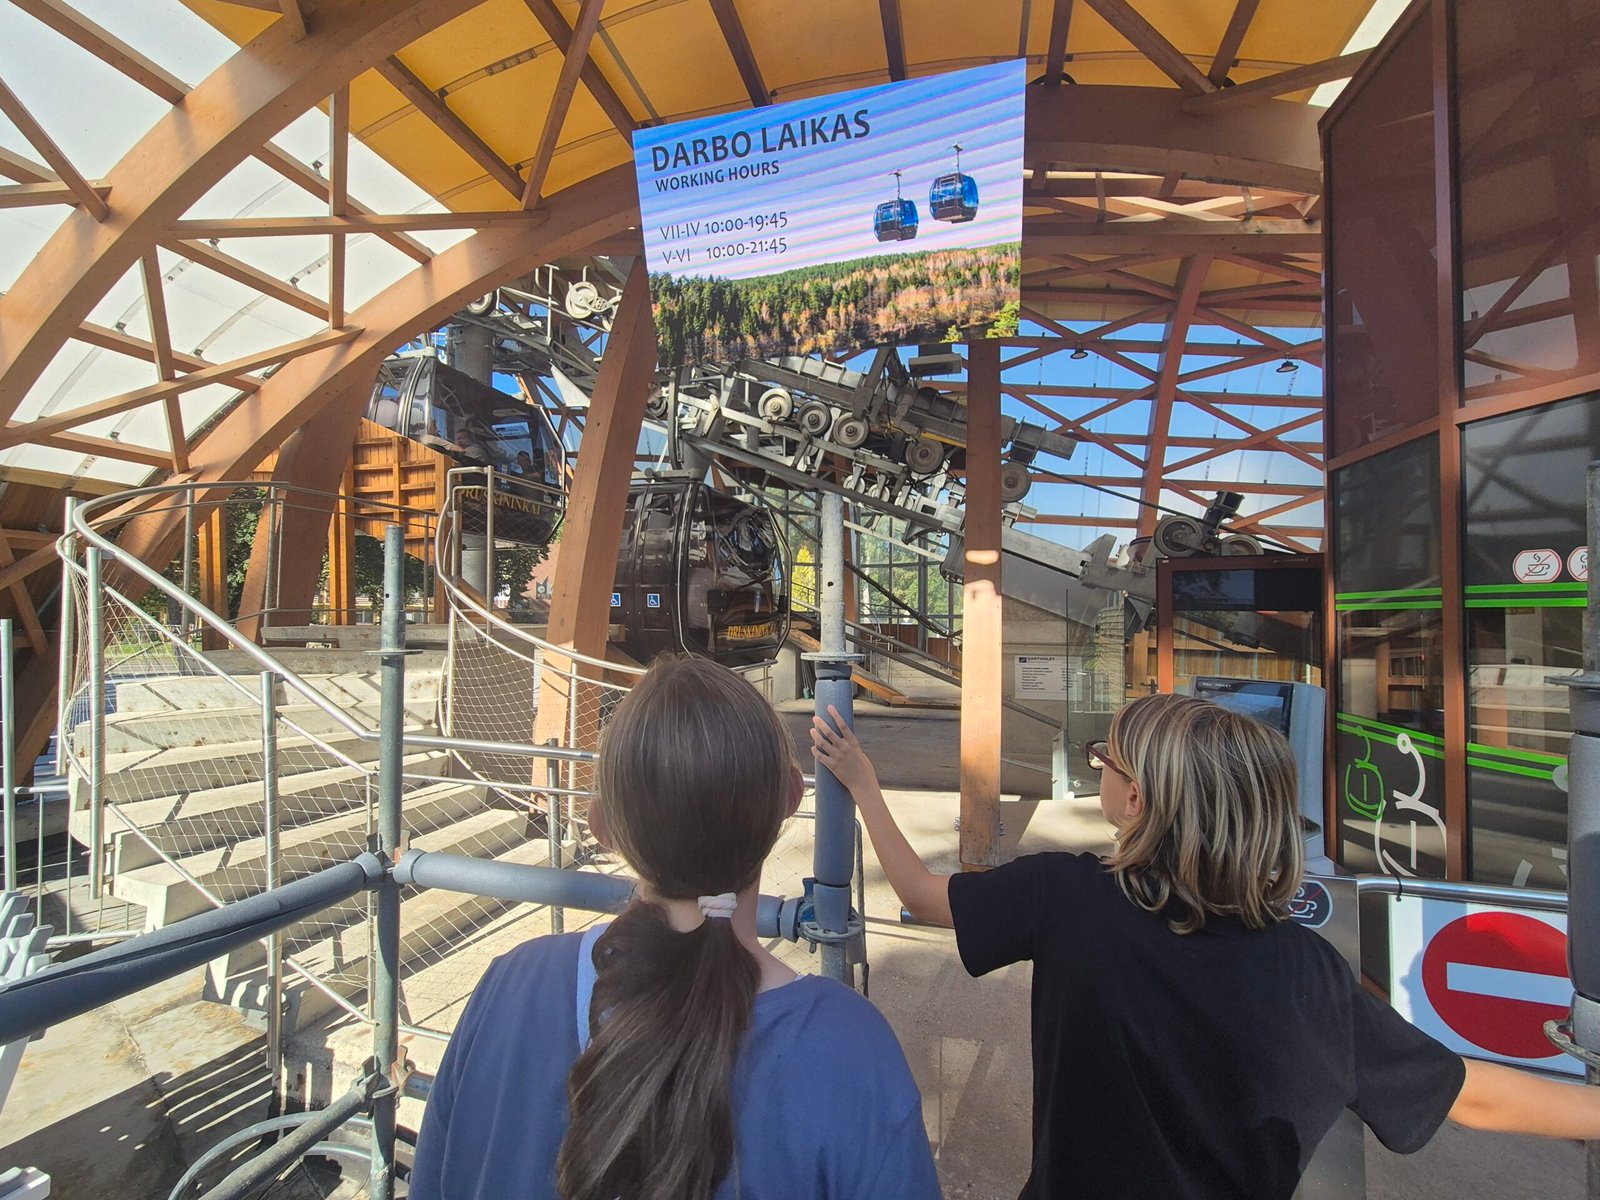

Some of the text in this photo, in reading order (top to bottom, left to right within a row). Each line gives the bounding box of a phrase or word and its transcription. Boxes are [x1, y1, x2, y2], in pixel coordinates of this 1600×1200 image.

[651, 109, 871, 172] DARBO LAIKAS
[655, 160, 780, 193] WORKING HOURS
[660, 211, 788, 240] VII-IV 10:00-19:45
[662, 237, 788, 265] V-VI 10:00-21:45
